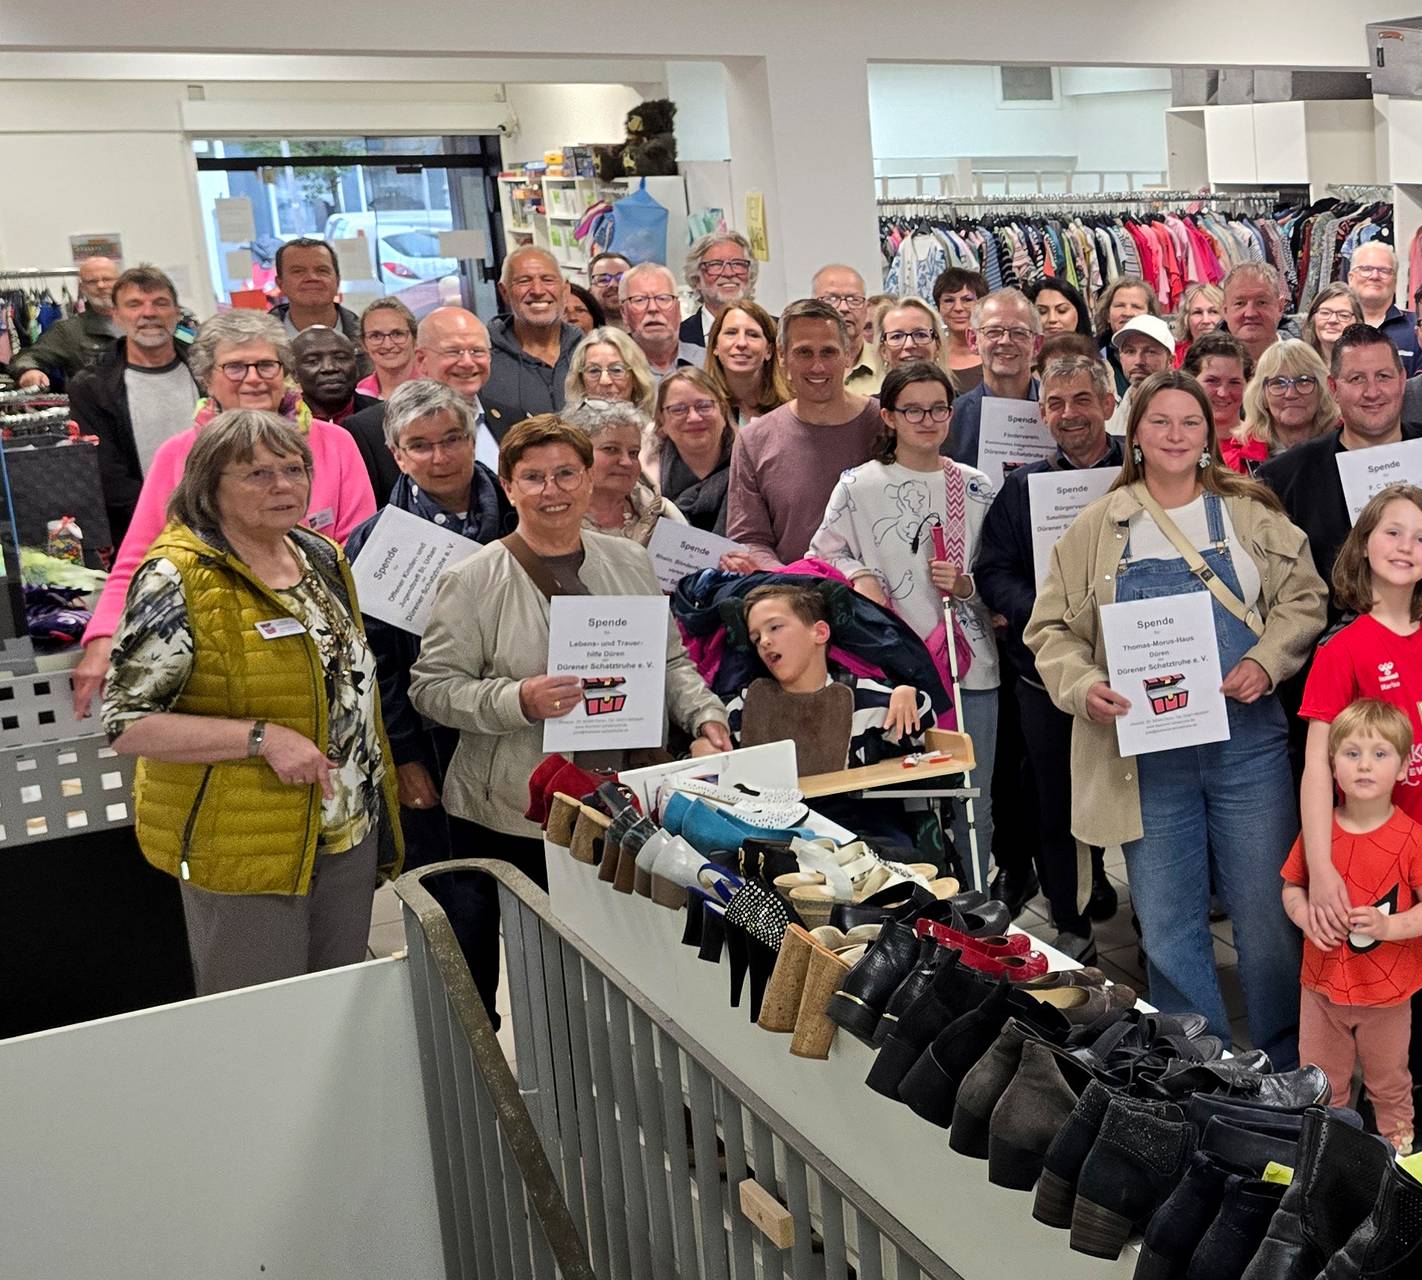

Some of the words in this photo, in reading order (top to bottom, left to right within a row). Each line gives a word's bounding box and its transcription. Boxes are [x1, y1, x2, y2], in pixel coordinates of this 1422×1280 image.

[1008, 414, 1038, 424] Spende
[1368, 460, 1400, 473] Spende
[1056, 485, 1088, 495] Spende
[680, 541, 710, 556] Spende
[374, 546, 399, 580] Spende
[402, 556, 419, 578] Kinder-
[406, 594, 424, 622] Dürener
[423, 556, 448, 595] Schatztruhe
[588, 618, 628, 628] Spende
[1136, 616, 1174, 630] Spende
[1123, 635, 1195, 652] Thomas-Morus-Haus
[1149, 650, 1170, 658] Düren
[557, 663, 588, 671] Dürener
[590, 662, 636, 670] Schatztruhe
[1117, 666, 1146, 676] Dürener
[1148, 658, 1191, 671] Schatztruhe
